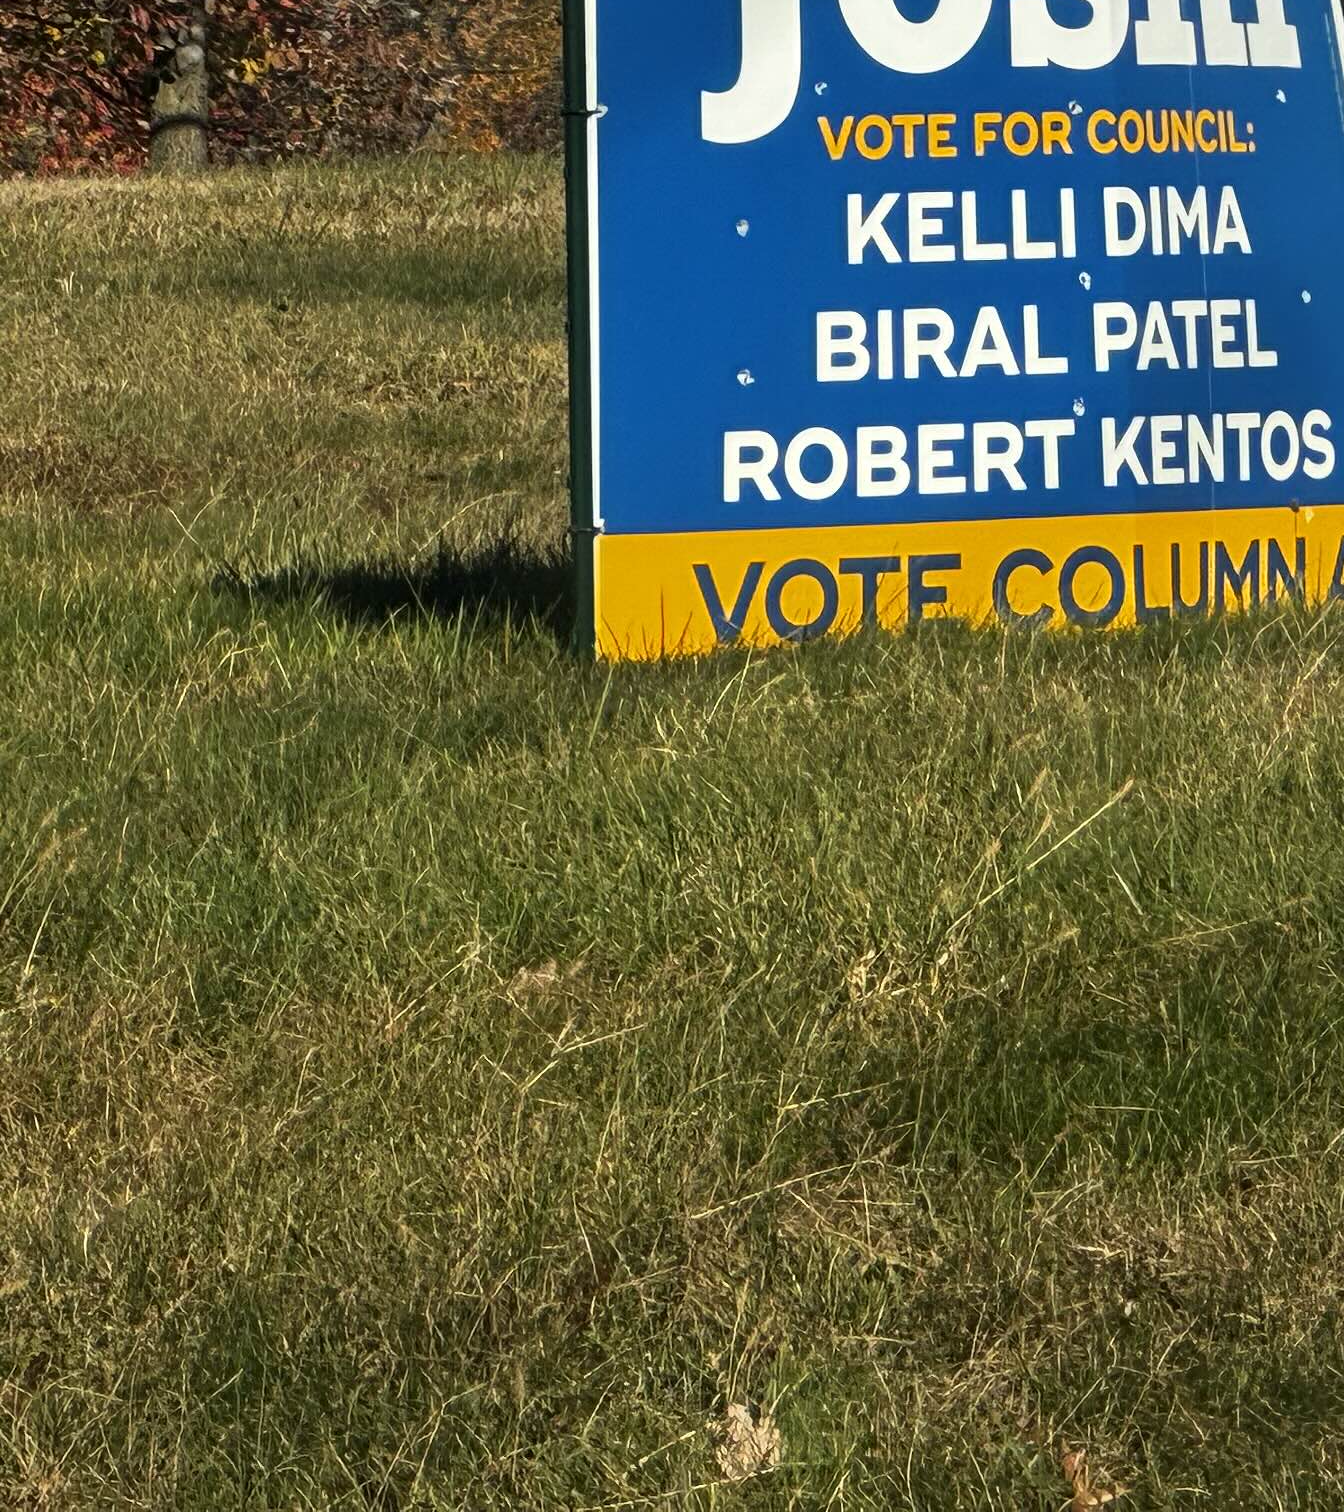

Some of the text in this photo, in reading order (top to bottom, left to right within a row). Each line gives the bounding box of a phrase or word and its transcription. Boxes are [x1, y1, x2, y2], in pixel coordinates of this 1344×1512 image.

[816, 108, 1257, 161] VOTE FOR COUNCIL:
[846, 185, 1253, 265] KELLI DIMA
[815, 299, 1279, 383] BIRAL PATEL
[722, 410, 1337, 504] ROBERT KENTOS
[992, 535, 1306, 628] COLUMN
